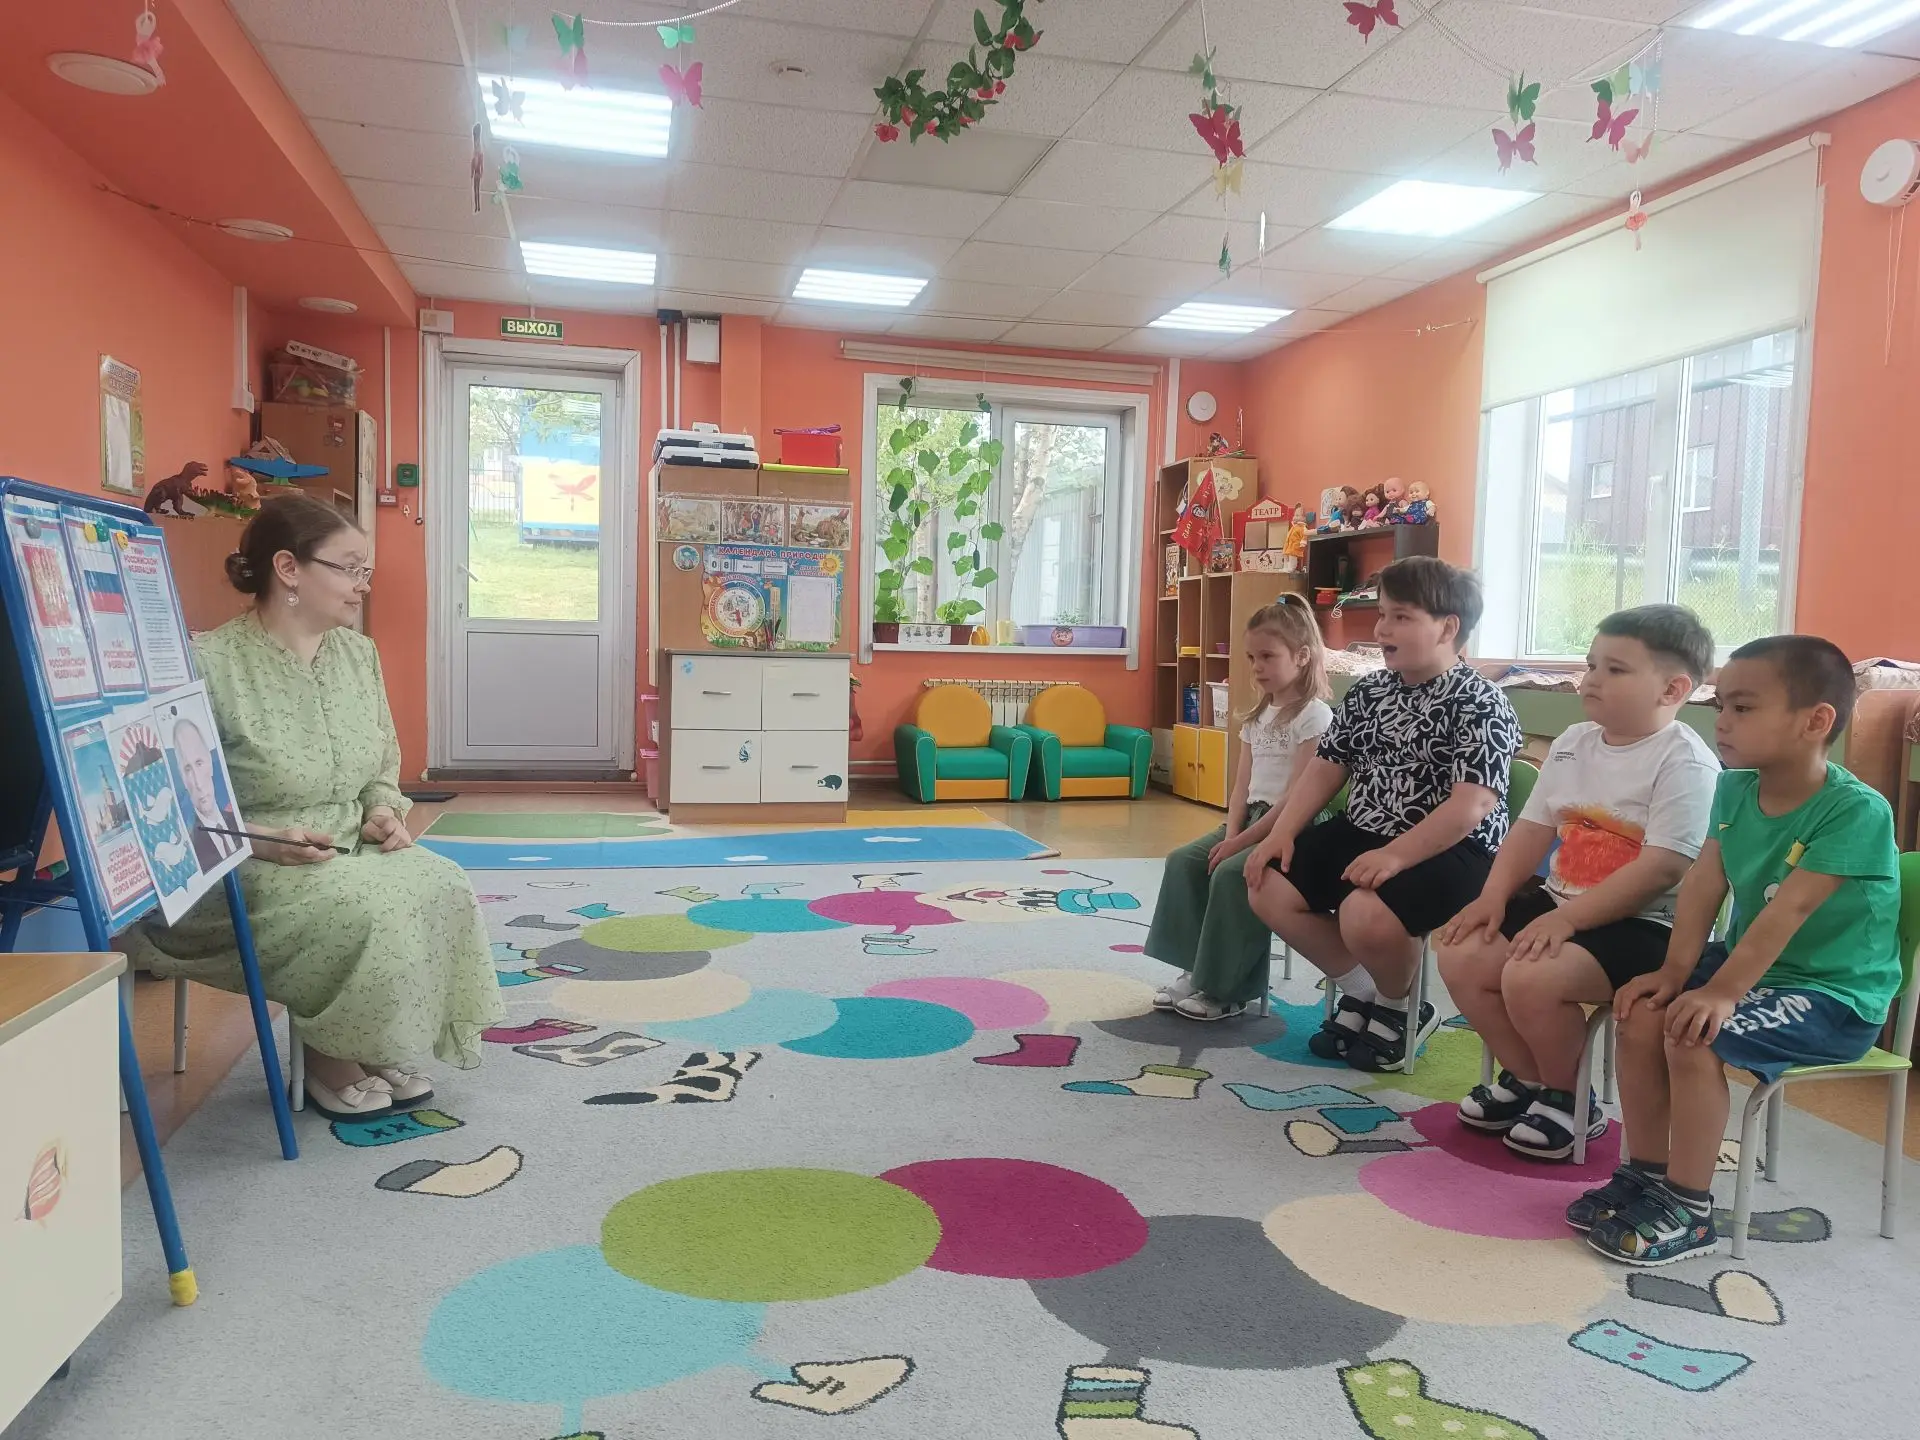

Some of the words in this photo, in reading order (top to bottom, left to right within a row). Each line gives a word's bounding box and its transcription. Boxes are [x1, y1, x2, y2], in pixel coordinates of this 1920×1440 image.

[507, 320, 558, 337] ВЫХОД
[1254, 507, 1280, 516] ТЕАТР
[718, 547, 777, 557] КАЛЕНДАРЬ
[781, 551, 827, 560] ПРИРОДЫ
